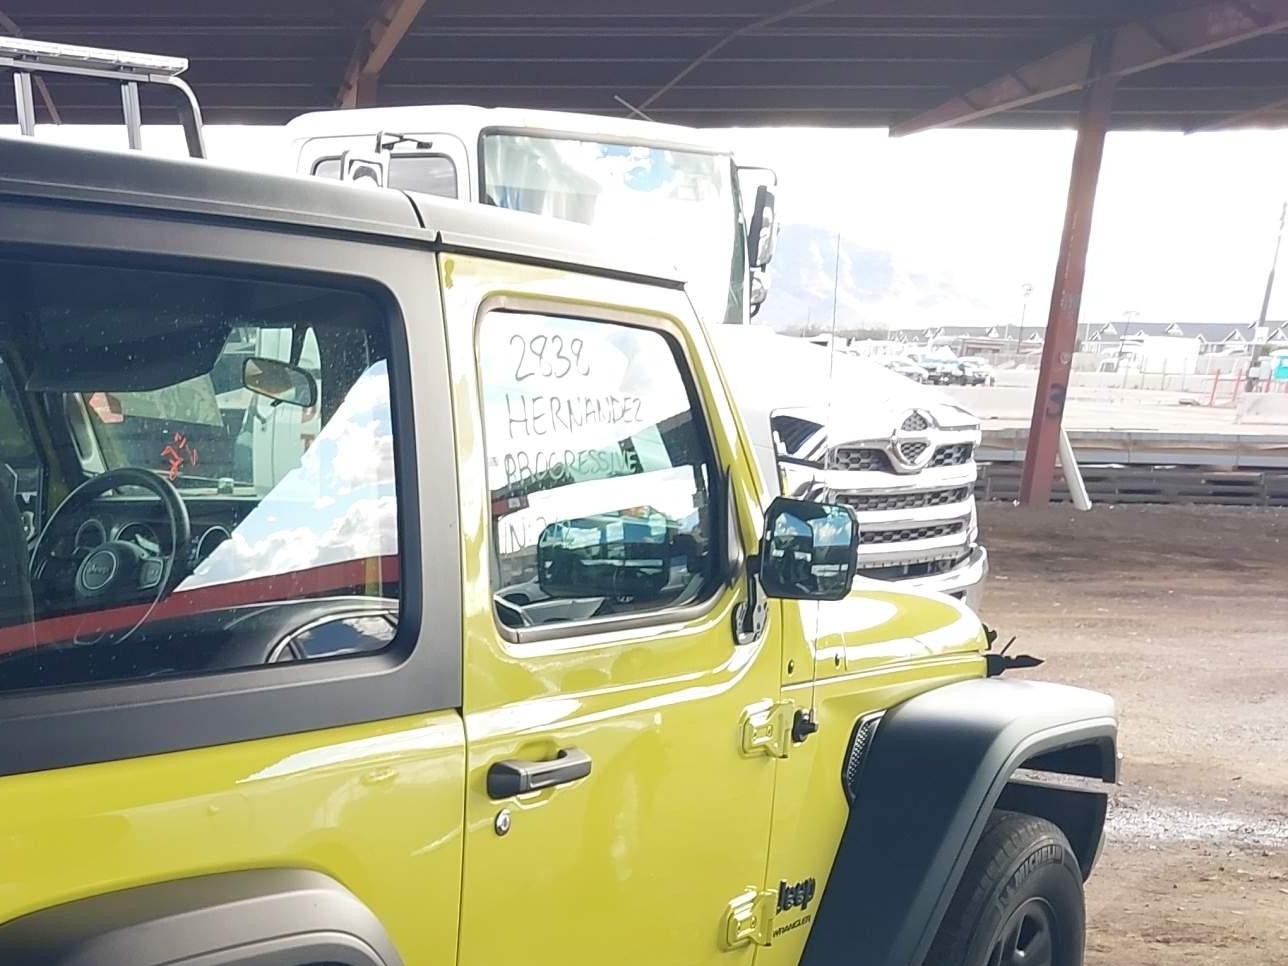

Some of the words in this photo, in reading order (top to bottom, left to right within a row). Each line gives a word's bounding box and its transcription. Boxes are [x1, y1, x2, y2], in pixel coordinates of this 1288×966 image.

[505, 393, 643, 438] HERNANDEZ
[504, 449, 637, 488] PROGRESSIVE
[776, 878, 816, 915] Jeep
[772, 915, 811, 937] WRANGLER
